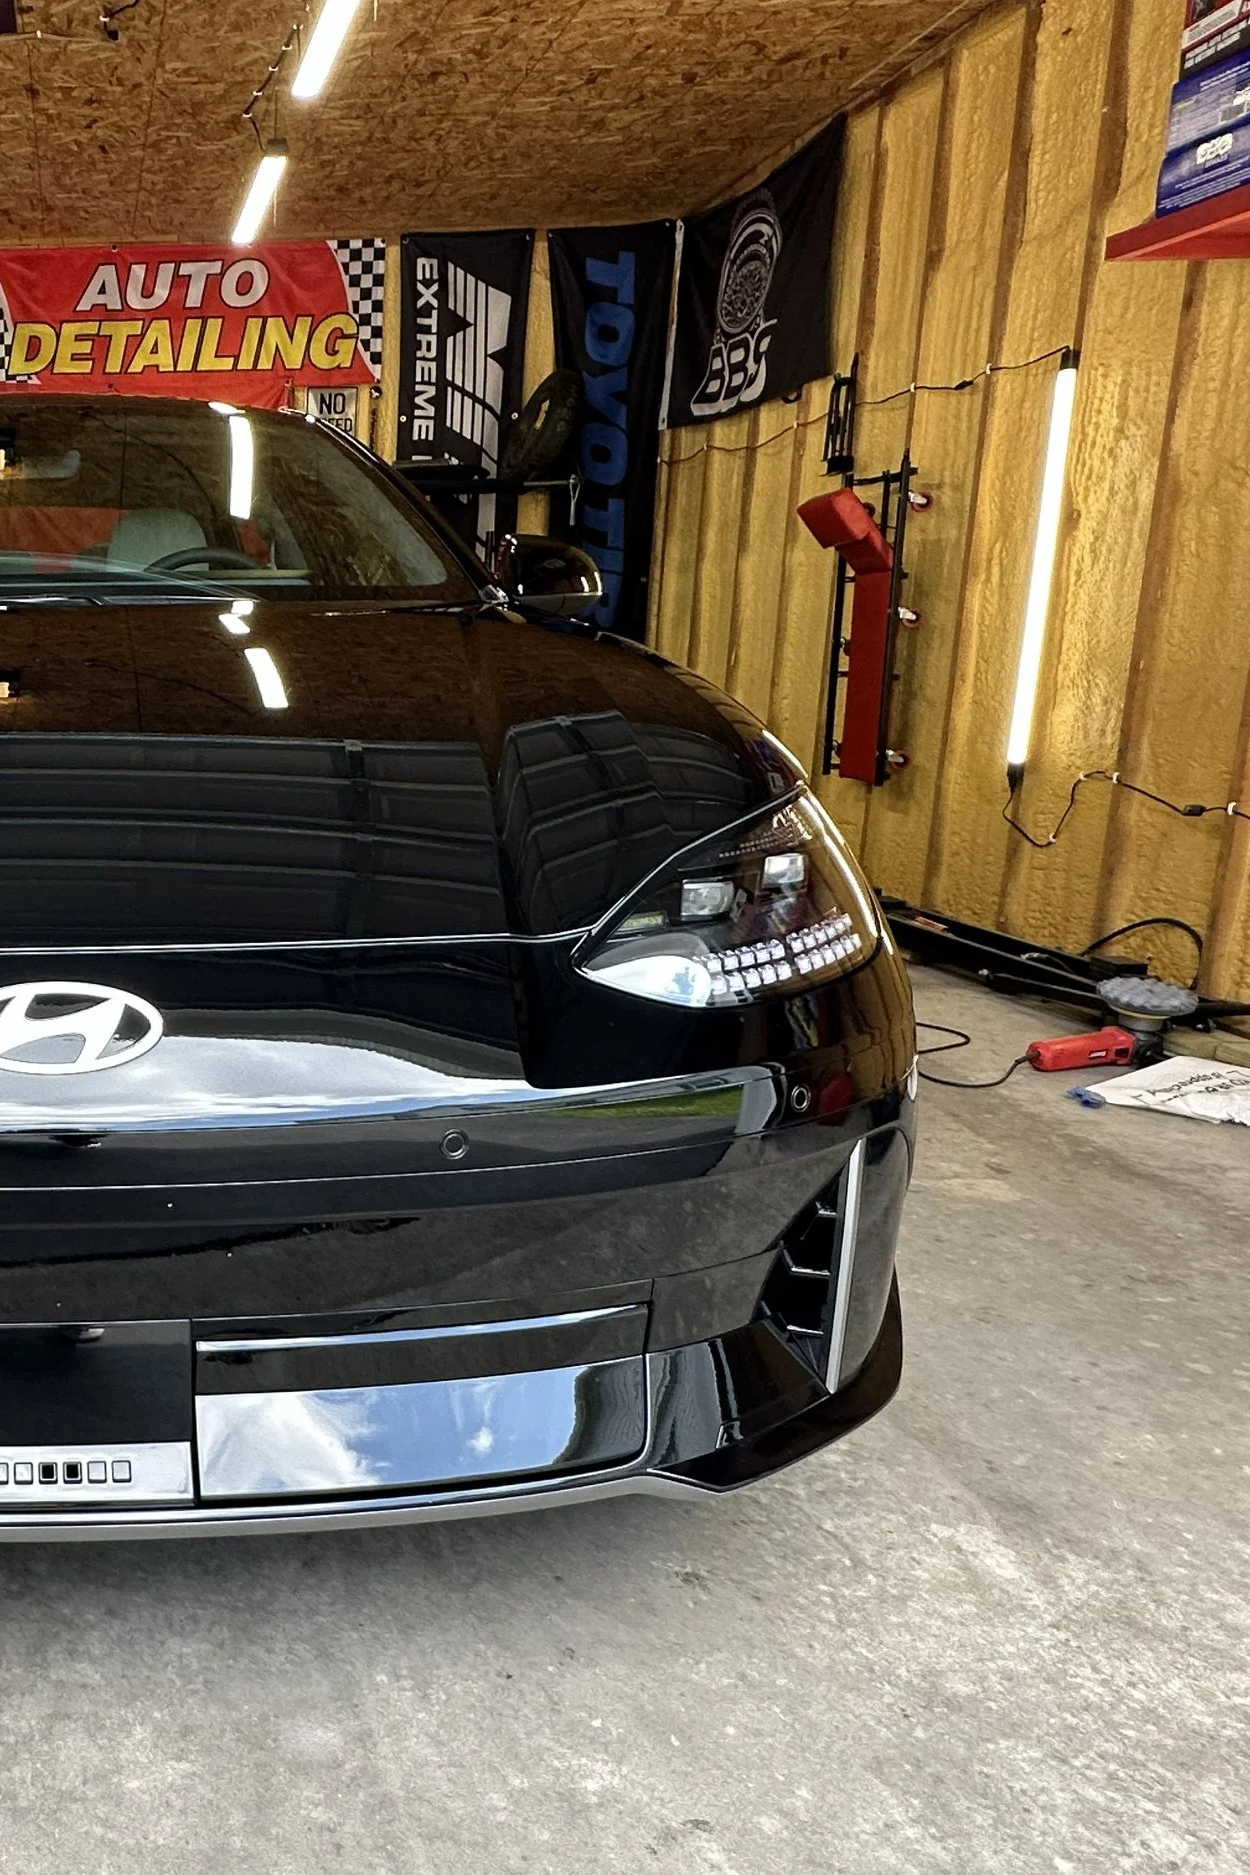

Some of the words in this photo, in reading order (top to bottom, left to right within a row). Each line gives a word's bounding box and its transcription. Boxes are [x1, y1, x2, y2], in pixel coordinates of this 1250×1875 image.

[74, 259, 269, 312] AUTO
[7, 313, 359, 375] DETAILING
[411, 256, 439, 441] EXTREME
[581, 251, 636, 487] TOYO
[690, 318, 778, 416] BBS
[319, 392, 346, 415] NO
